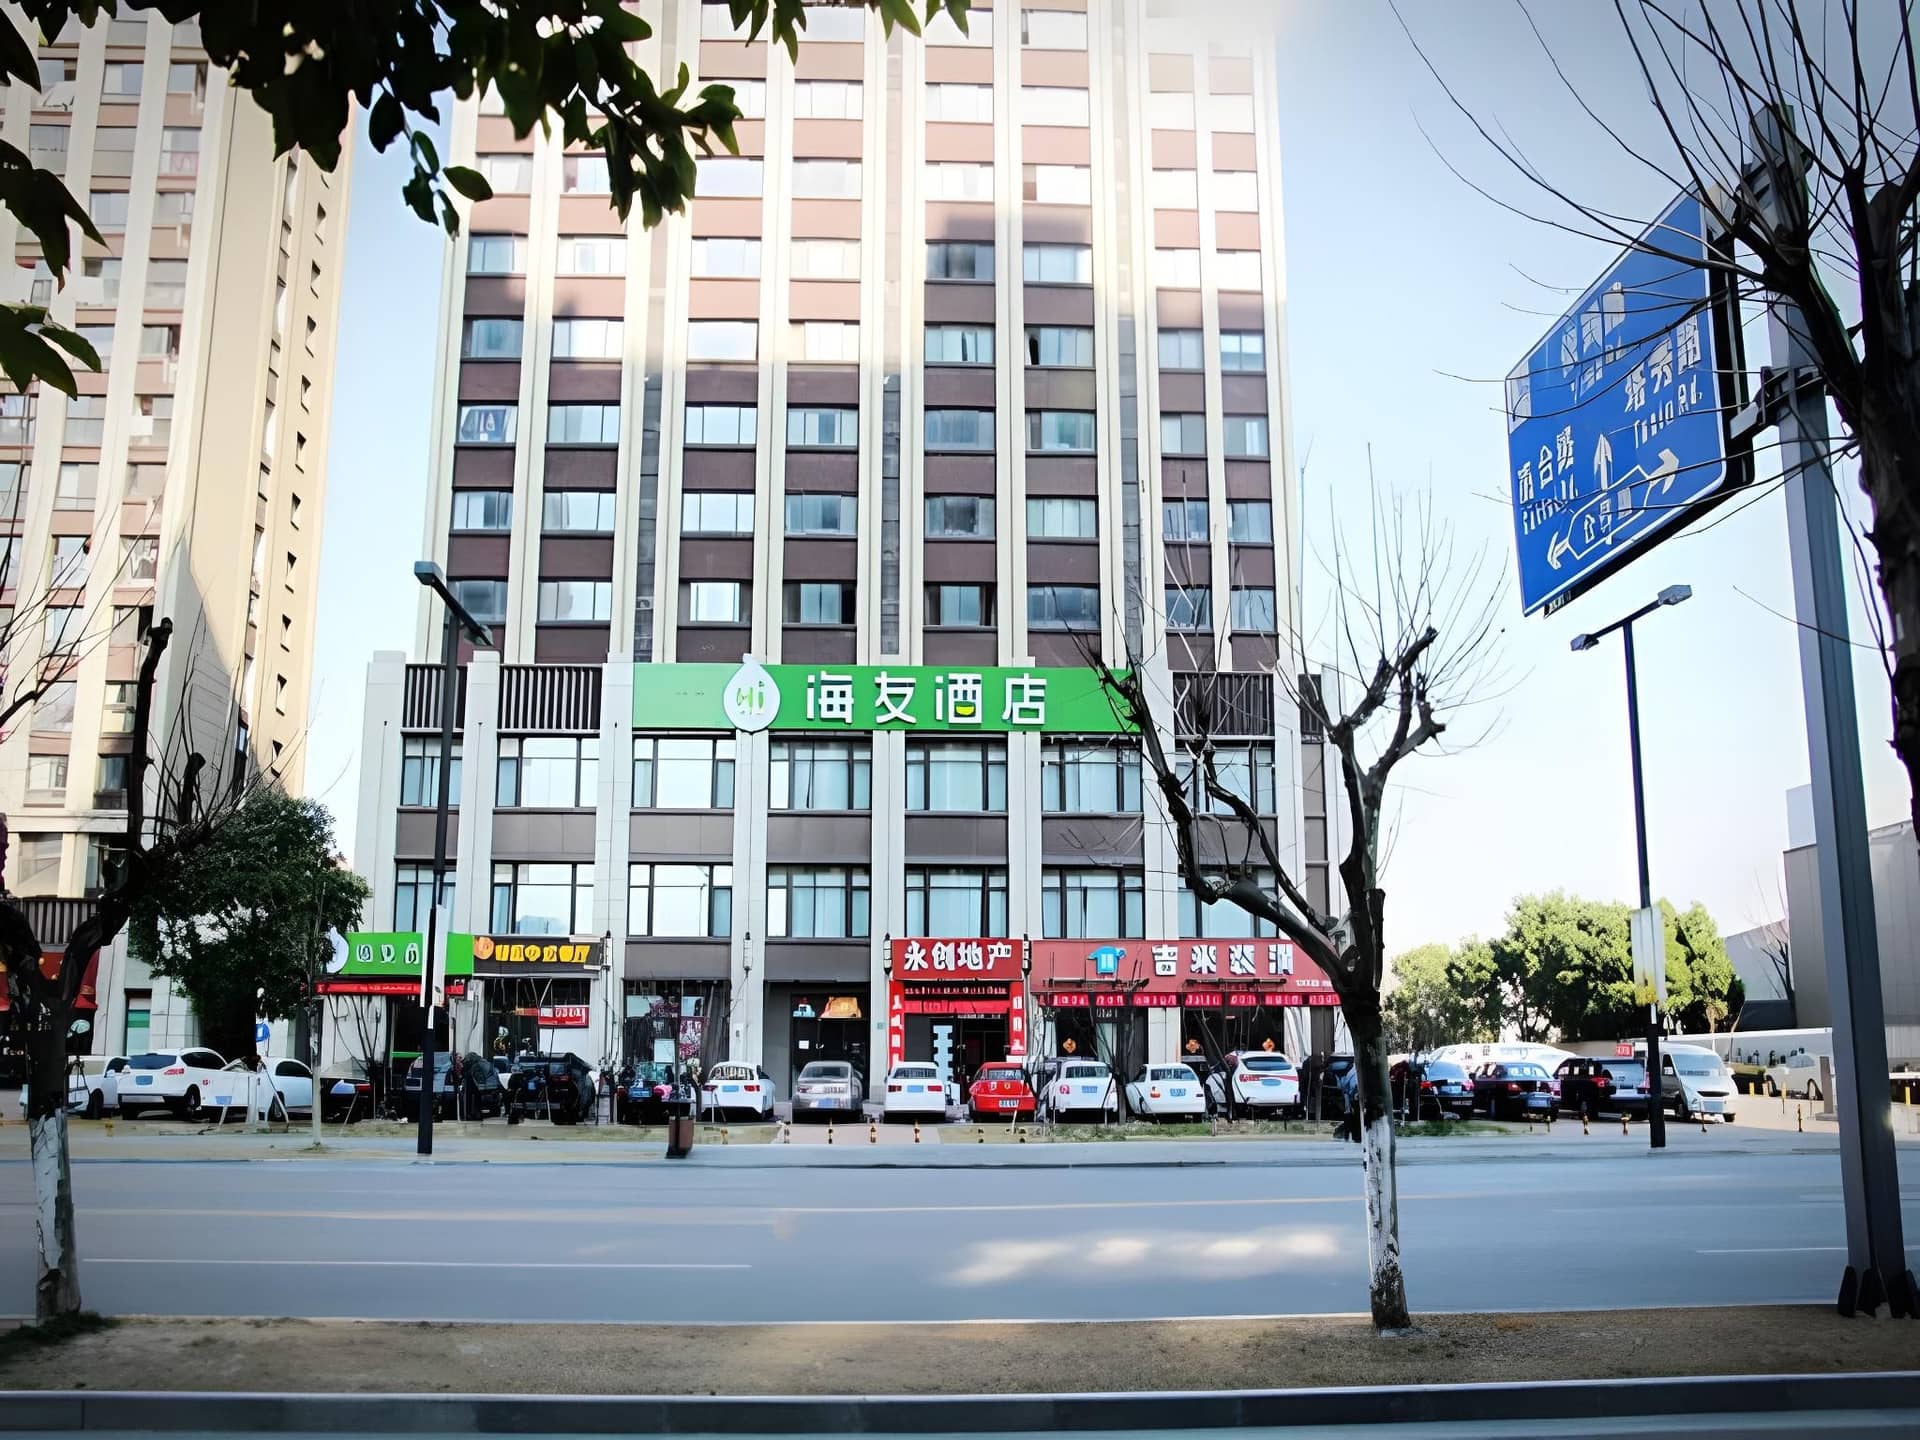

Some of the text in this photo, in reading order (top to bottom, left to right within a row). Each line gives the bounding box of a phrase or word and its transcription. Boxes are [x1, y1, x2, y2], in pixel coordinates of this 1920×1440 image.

[806, 670, 1048, 724] 海友酒店
[904, 941, 1012, 971] 永创地产
